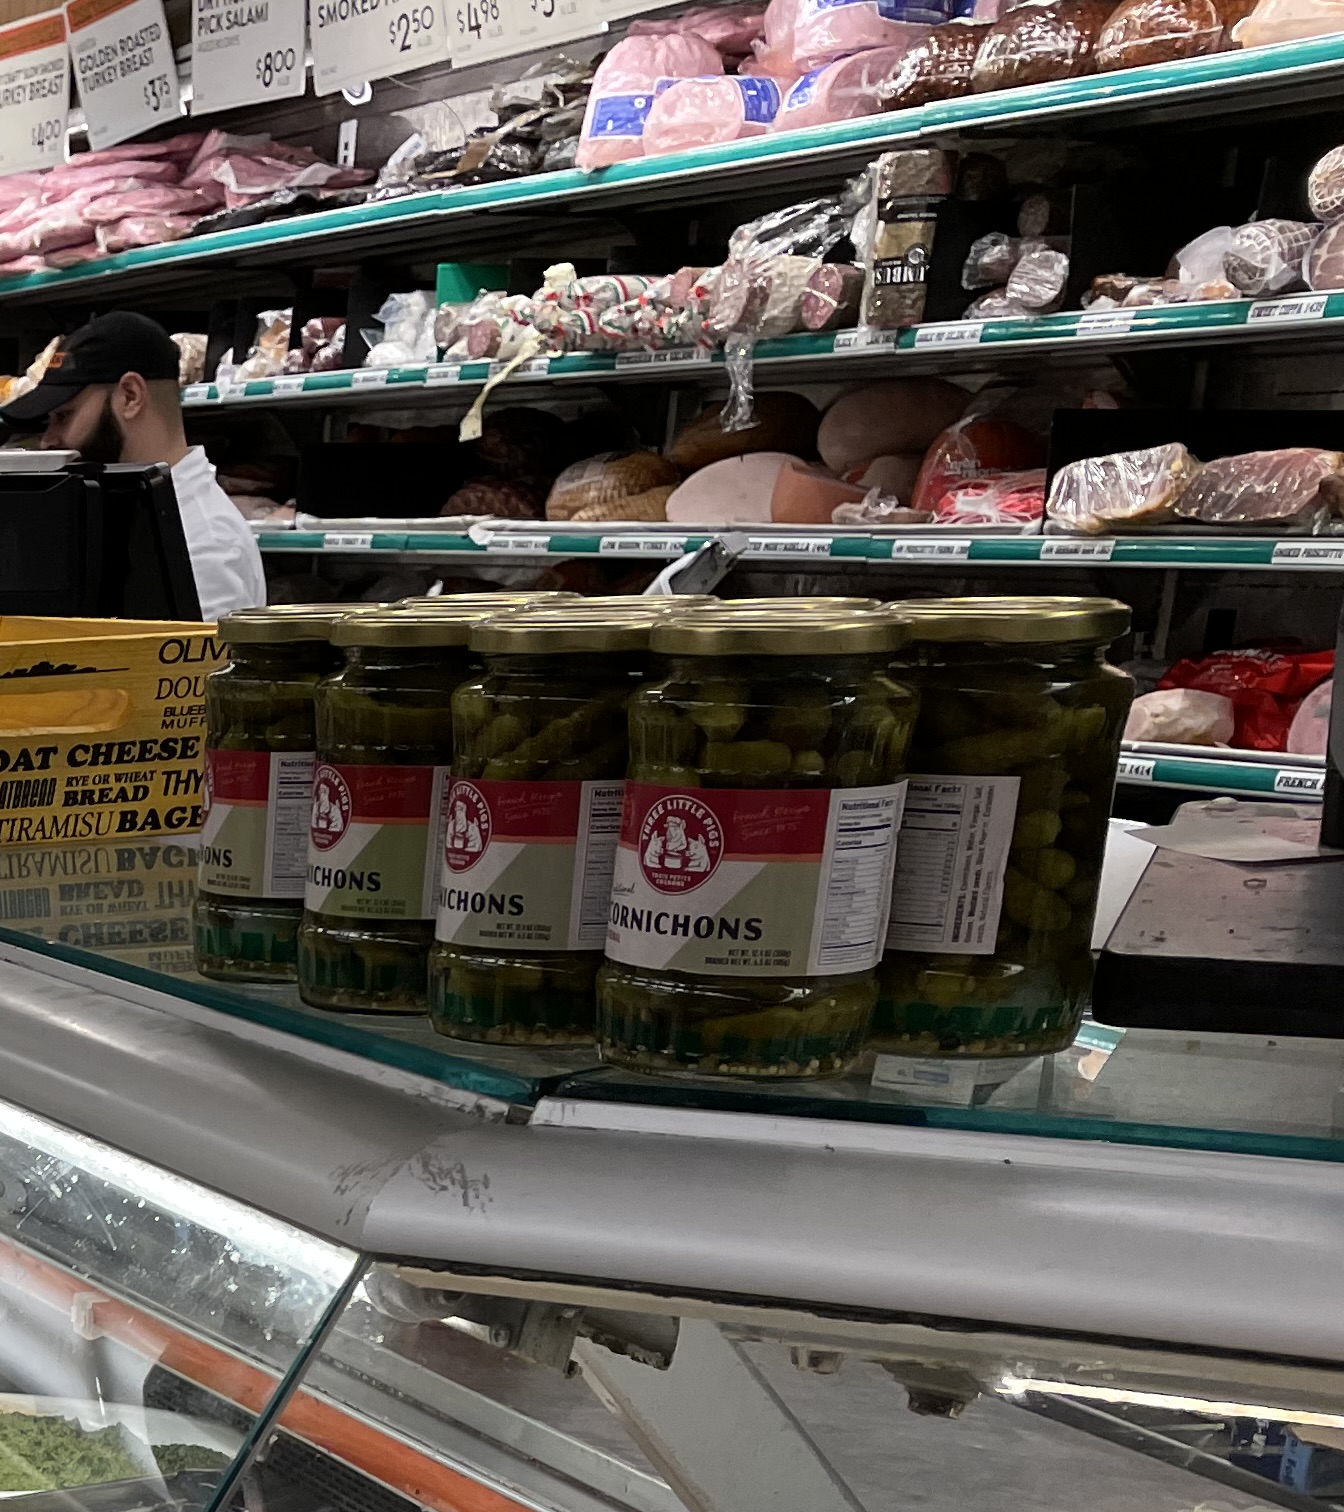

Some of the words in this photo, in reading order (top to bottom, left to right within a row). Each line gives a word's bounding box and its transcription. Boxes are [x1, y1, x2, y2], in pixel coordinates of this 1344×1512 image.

[198, 14, 224, 36] PICK
[226, 2, 269, 31] SALAMI
[318, 0, 378, 28] SMOKED
[79, 45, 119, 74] GOLDEN
[119, 22, 162, 53] ROASTED
[82, 66, 119, 94] TURKEY
[120, 48, 154, 77] BREAST
[28, 74, 64, 100] BREAST
[155, 677, 205, 700] DOU
[161, 716, 207, 730] MUFF
[163, 705, 206, 717] BLUEB
[66, 736, 200, 769] CHEESE
[66, 776, 89, 788] RYE
[92, 774, 110, 786] OR
[114, 770, 158, 784] WHEAT
[162, 769, 204, 796] THY
[1276, 776, 1319, 788] FRENCH
[62, 785, 150, 808] BREAD
[642, 803, 665, 841] THREE
[666, 799, 705, 819] LITTLE
[703, 815, 720, 848] PIGS
[310, 865, 382, 892] ICHONS
[443, 888, 524, 916] ICHONS
[611, 901, 763, 941] ORNICHONS
